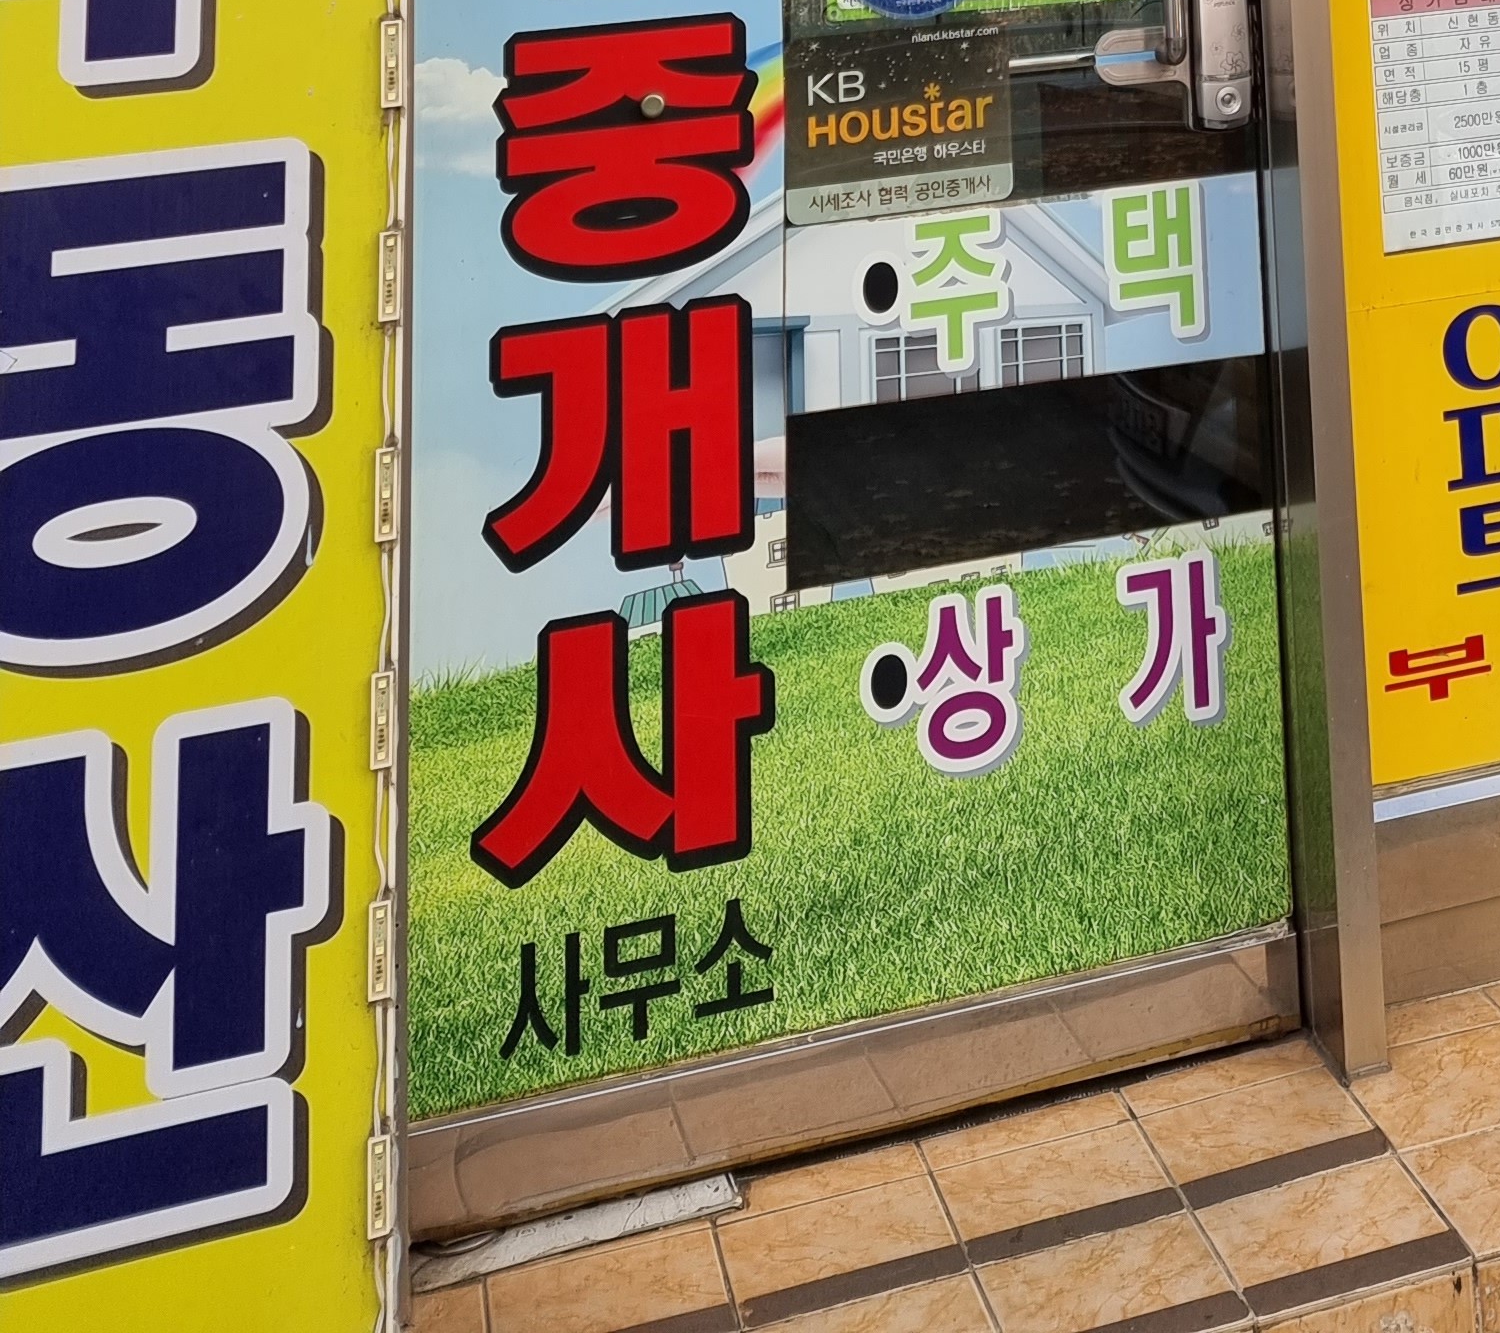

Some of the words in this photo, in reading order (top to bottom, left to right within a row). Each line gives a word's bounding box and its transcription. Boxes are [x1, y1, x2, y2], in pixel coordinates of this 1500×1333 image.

[807, 71, 866, 107] KB
[873, 145, 927, 165] 국민은행
[934, 140, 986, 159] 하우스타
[1386, 154, 1425, 168] 보증금
[809, 190, 872, 212] 시세조사
[878, 185, 908, 203] 협력
[915, 175, 991, 200] 공인중개사
[499, 898, 776, 1062] 사무소
